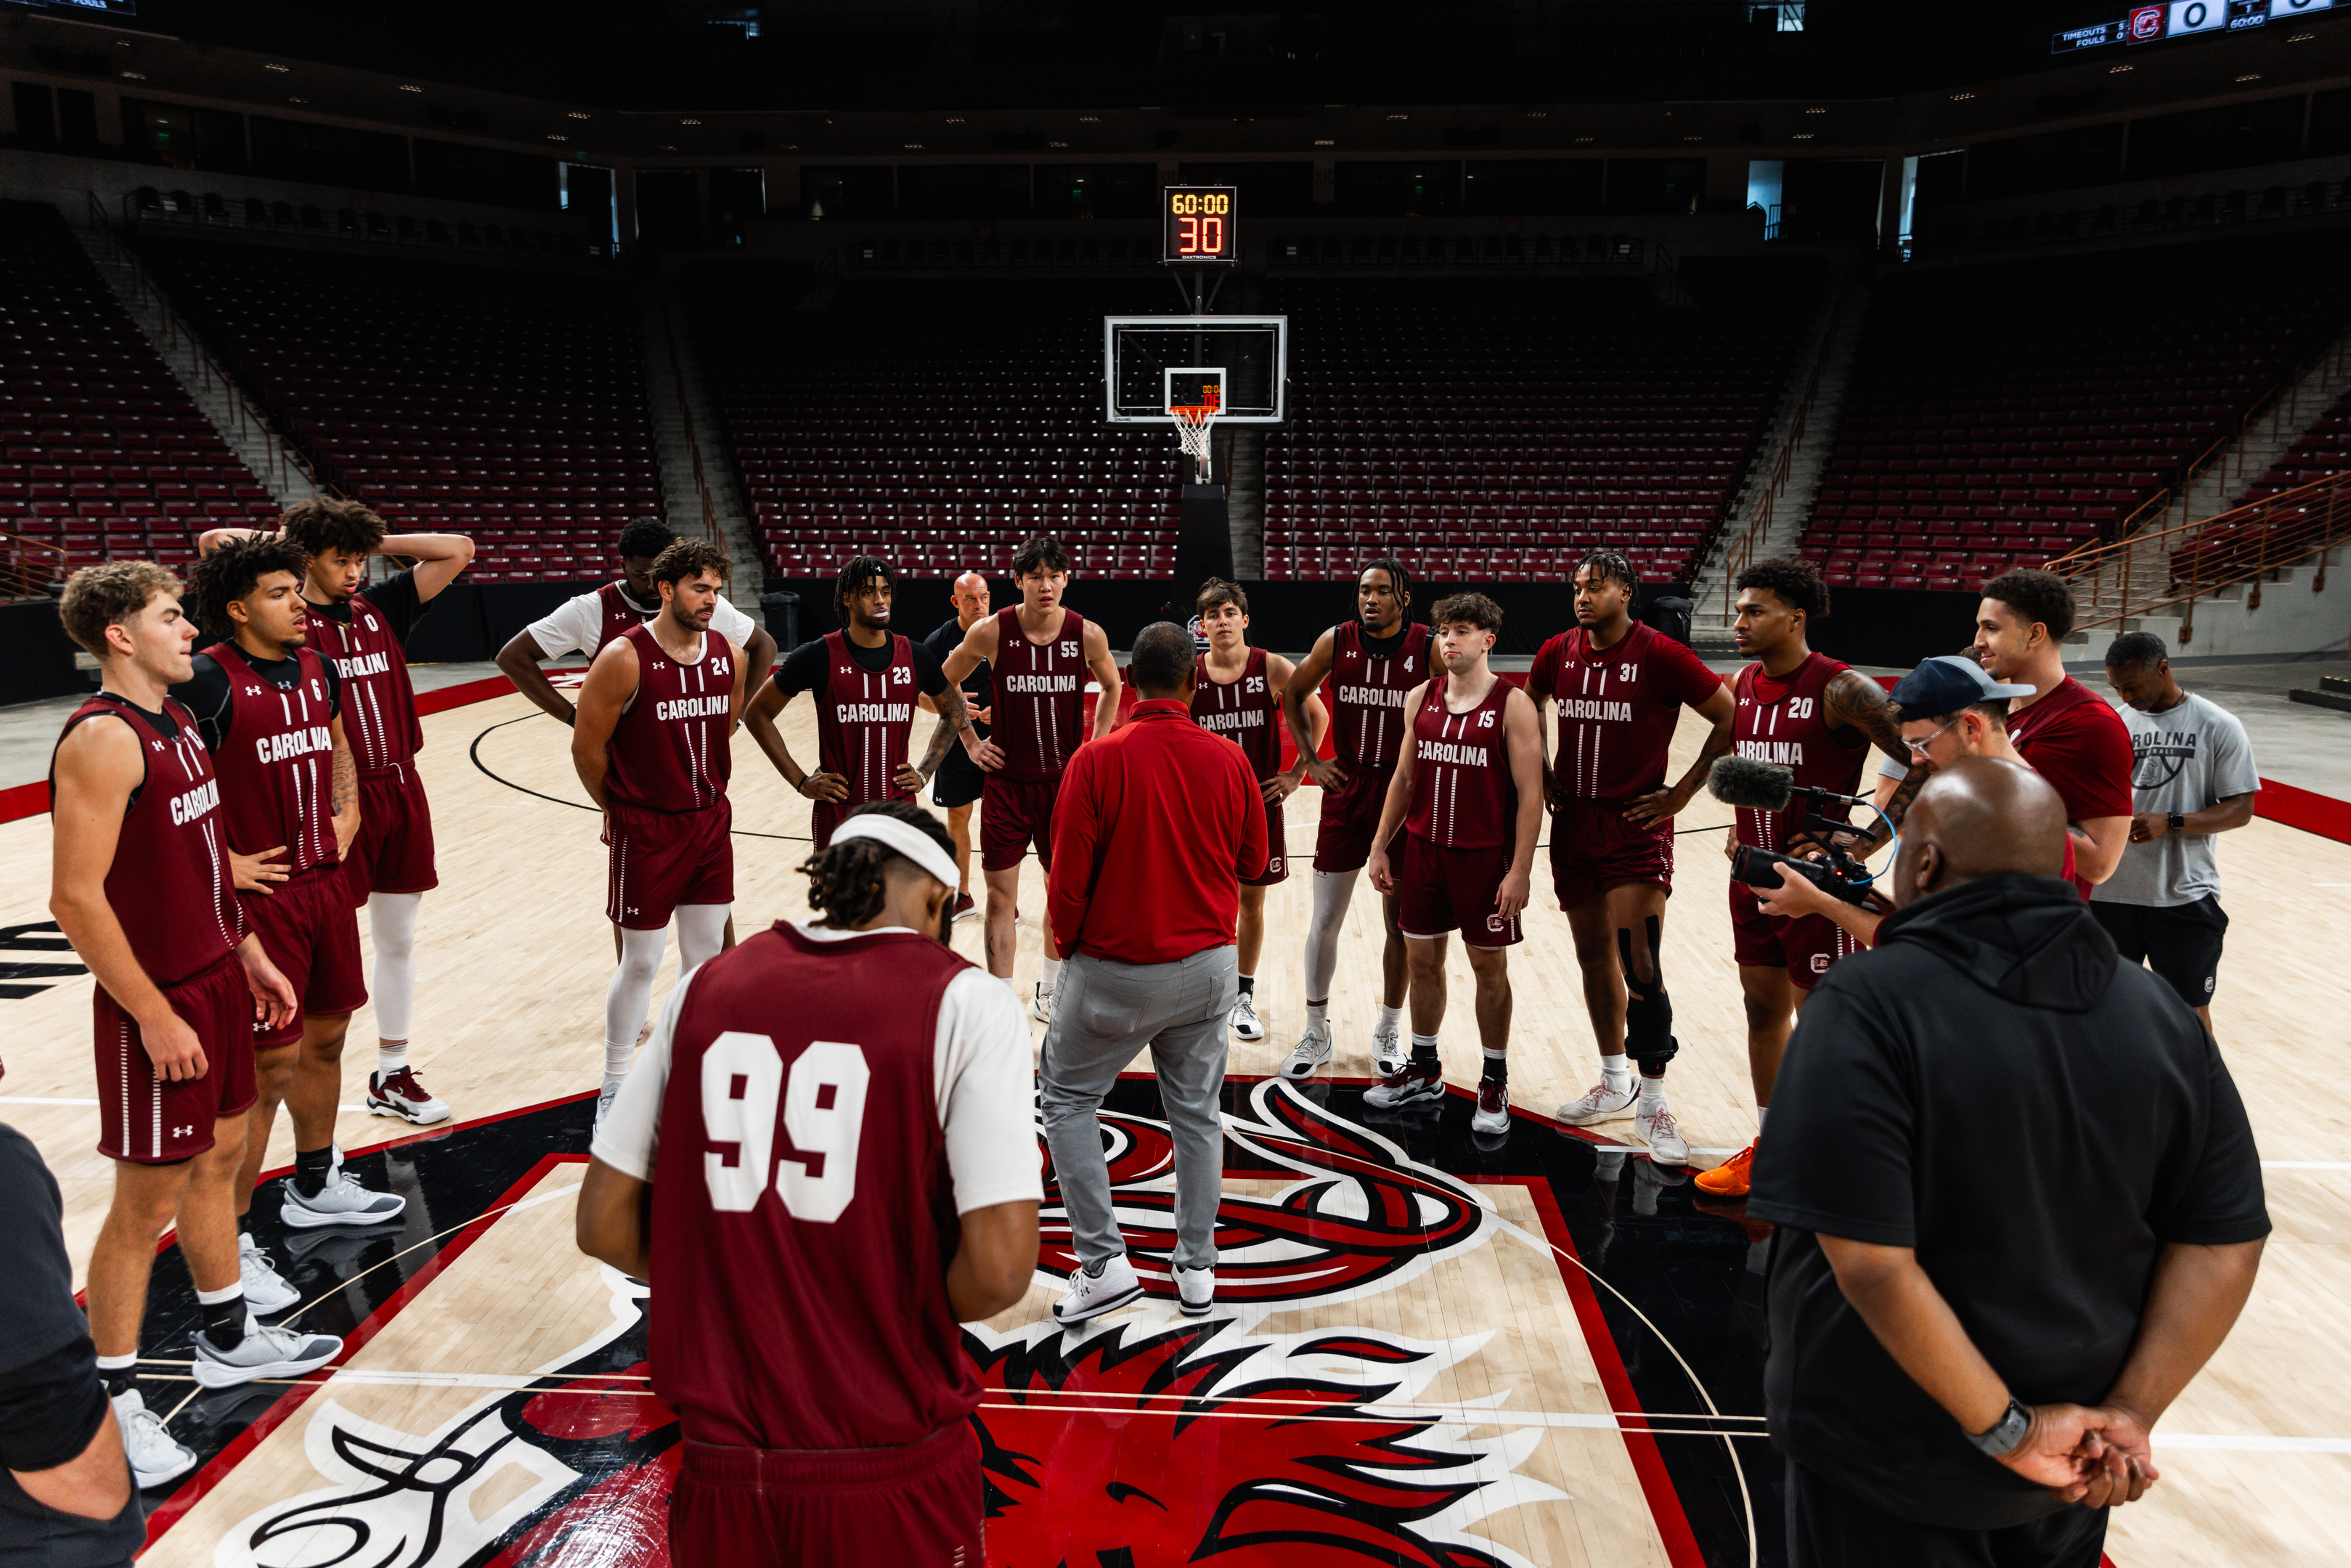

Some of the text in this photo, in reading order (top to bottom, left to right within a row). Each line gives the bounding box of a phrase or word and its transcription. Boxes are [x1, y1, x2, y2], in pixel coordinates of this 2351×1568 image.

[2183, 2, 2207, 28] 0
[2246, 5, 2252, 14] 1
[2230, 15, 2264, 29] 60:00
[2062, 27, 2106, 41] TIMEOUTS
[2076, 36, 2105, 47] FOULS
[1173, 194, 1229, 214] 60:00
[1178, 217, 1222, 253] 30
[364, 613, 379, 632] 0
[1061, 641, 1078, 658] 55
[711, 656, 730, 676] 24
[1403, 656, 1414, 673] 4
[1619, 663, 1638, 682] 31
[892, 666, 911, 685] 23
[1006, 674, 1076, 693] CAROLINA
[1246, 676, 1264, 693] 25
[311, 678, 322, 701] 6
[656, 695, 729, 721] CAROLINA
[836, 703, 910, 723] CAROLINA
[1557, 698, 1632, 722] CAROLINA
[1788, 697, 1814, 719] 20
[1199, 709, 1265, 731] CAROLINA
[1478, 710, 1496, 728] 15
[2132, 731, 2197, 748] ROLINA
[170, 777, 221, 826] CAROLIN
[701, 1030, 871, 1223] 99
